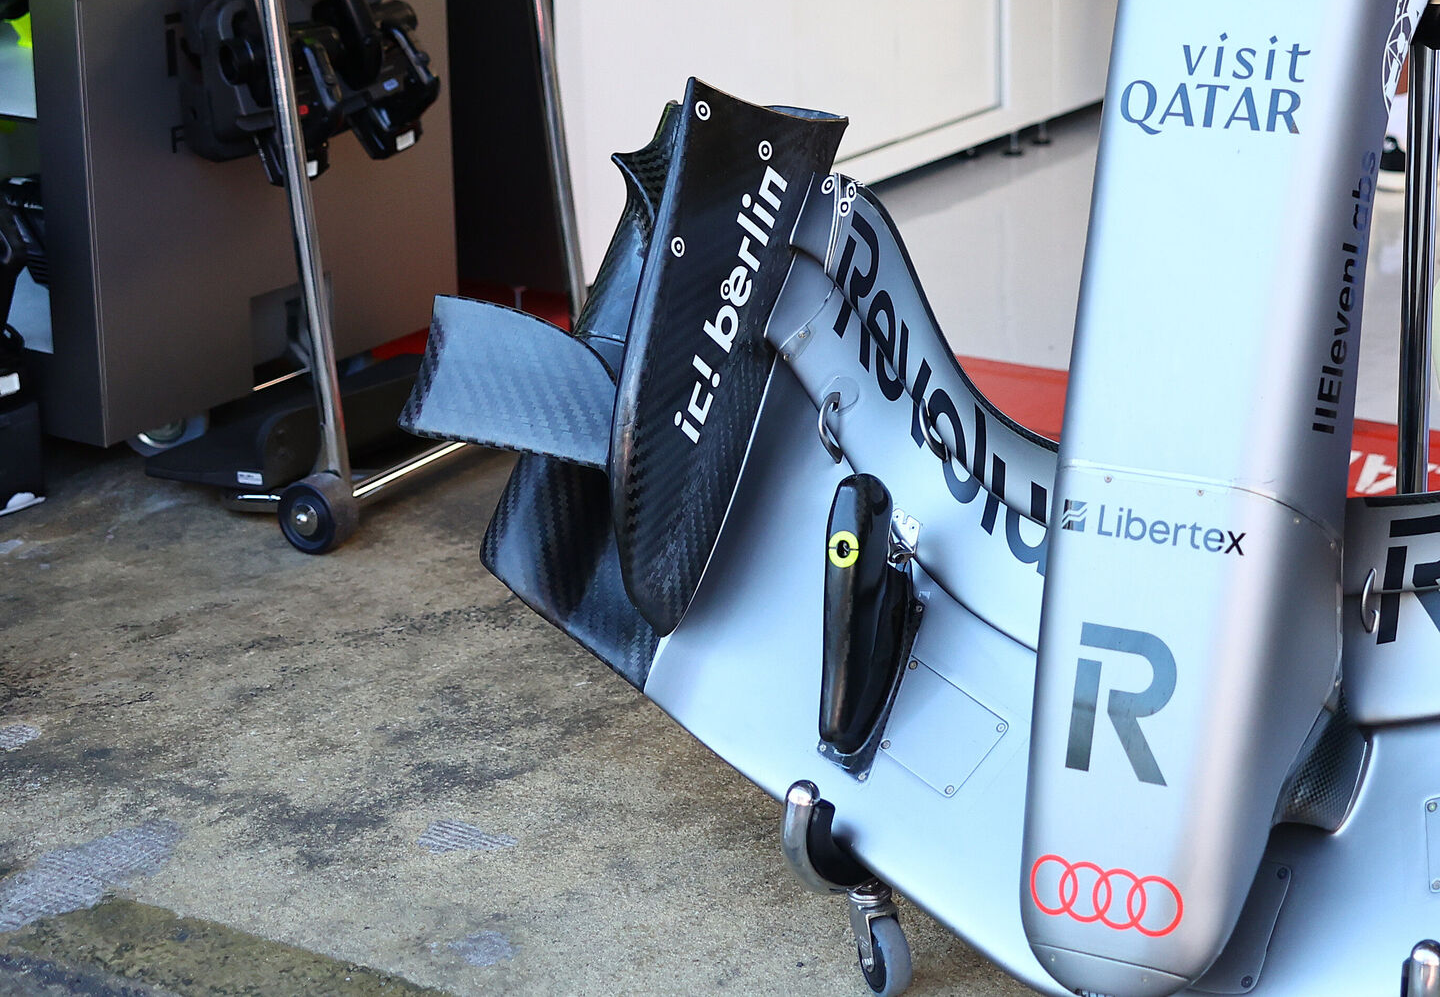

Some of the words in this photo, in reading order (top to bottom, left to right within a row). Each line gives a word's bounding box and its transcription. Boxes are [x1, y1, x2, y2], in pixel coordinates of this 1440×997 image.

[1182, 32, 1311, 83] visit
[1120, 79, 1301, 135] QATAR
[703, 165, 788, 353] berlin
[1096, 504, 1245, 556] Libertex
[1064, 620, 1178, 787] R
